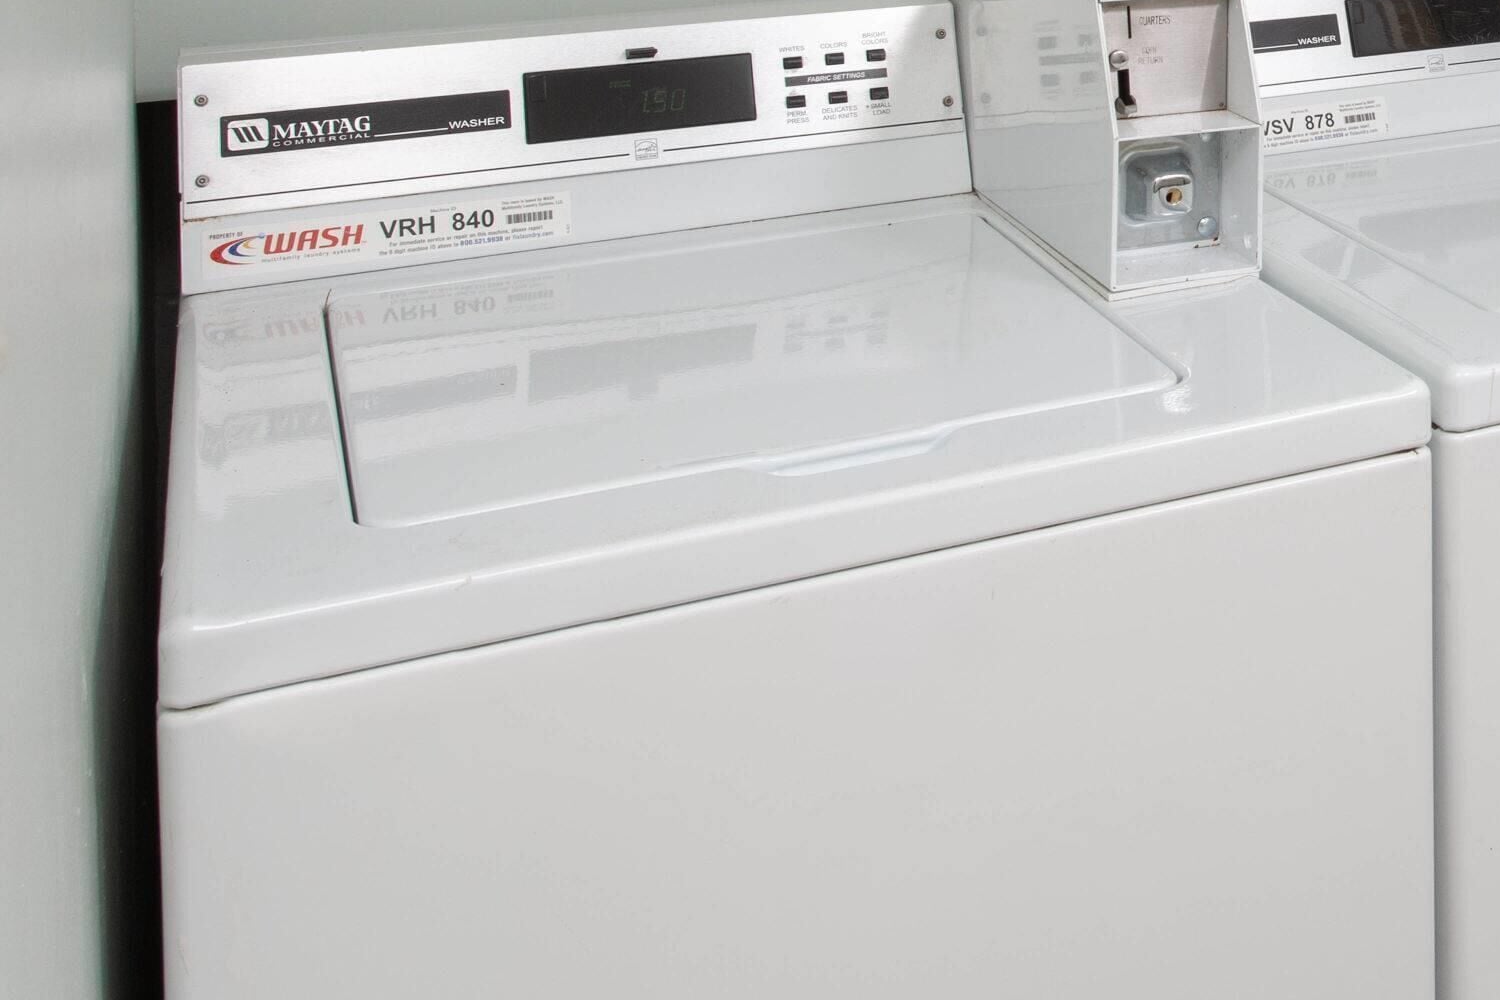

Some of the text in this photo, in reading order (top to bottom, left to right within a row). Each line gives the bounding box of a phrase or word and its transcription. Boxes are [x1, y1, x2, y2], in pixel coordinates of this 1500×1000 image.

[861, 31, 886, 39] BRIGHT
[860, 38, 888, 46] COLORS
[1297, 35, 1337, 46] WASHER
[779, 45, 805, 53] WHITES
[819, 42, 848, 50] COLORS
[807, 71, 866, 83] FABRIC SETTINGS
[821, 106, 858, 114] DELICATES
[870, 102, 892, 110] SMALL
[786, 110, 807, 118] PERM
[822, 113, 837, 121] AND
[448, 116, 506, 130] WASHER
[786, 117, 810, 125] PRESS
[1304, 112, 1335, 131] 878
[272, 115, 371, 141] MAYTAG
[272, 133, 371, 147] COMMERCIAL
[380, 209, 495, 239] VRH 840
[209, 232, 235, 240] PROPERTY
[264, 224, 364, 255] WASH
[261, 254, 301, 263] multifamily
[304, 251, 330, 260] laundry
